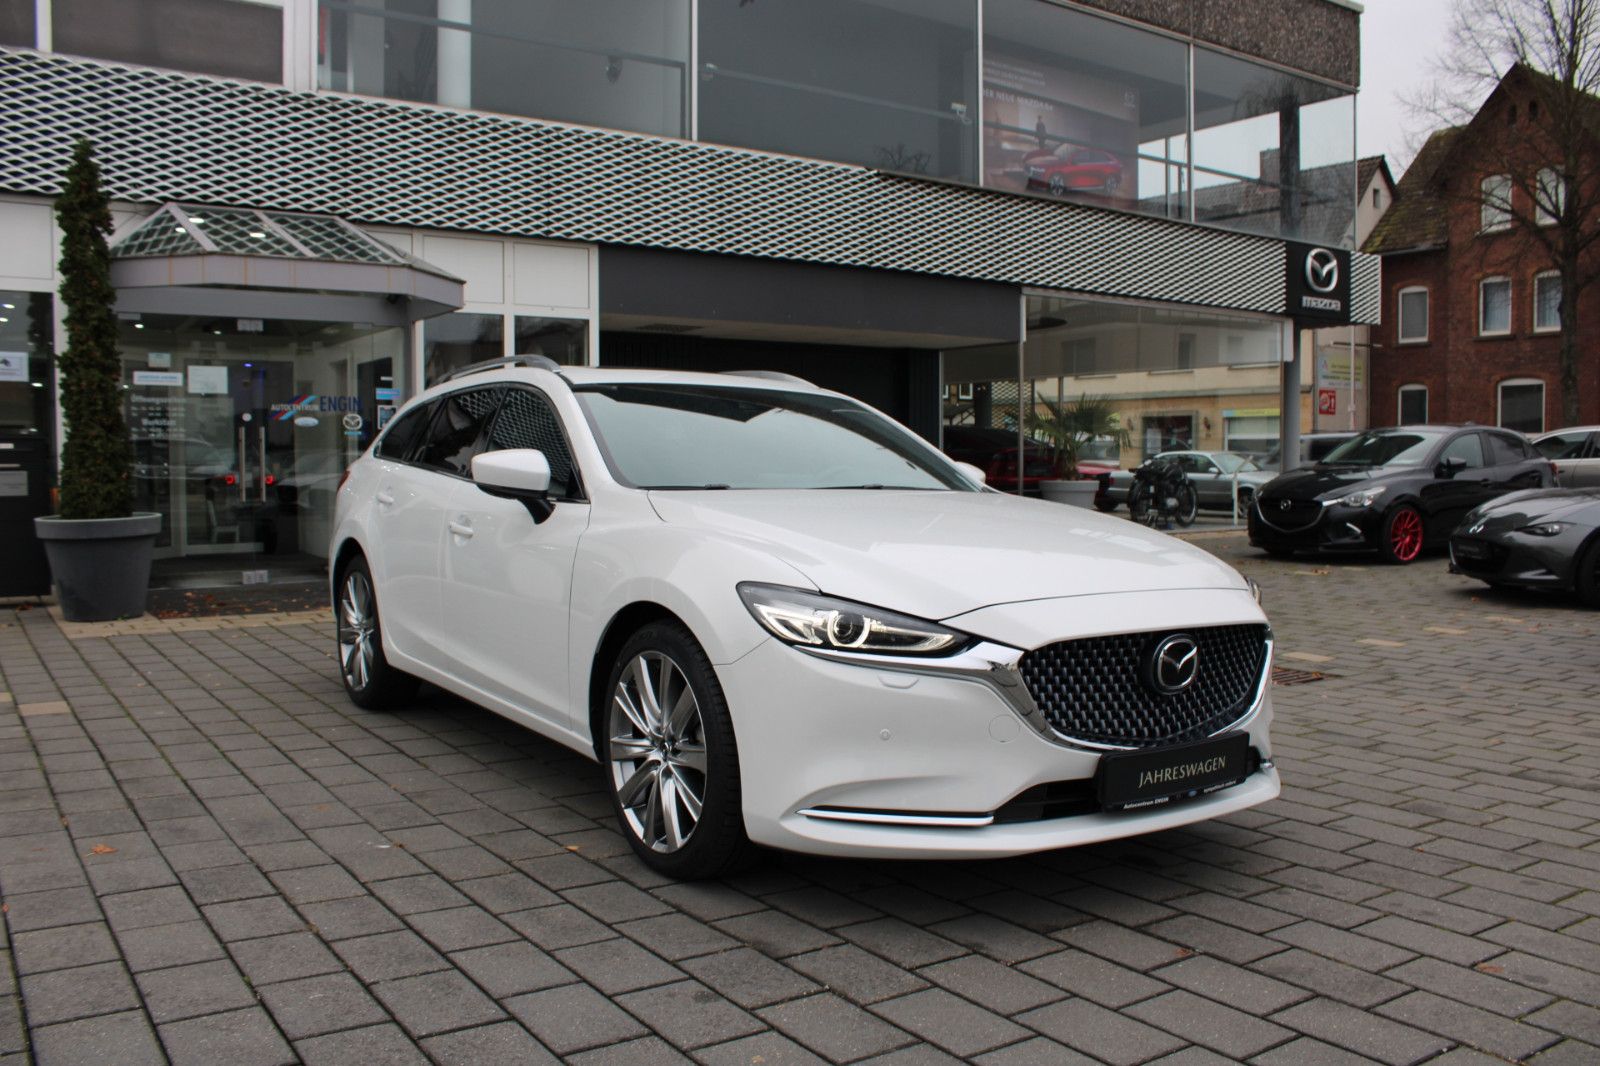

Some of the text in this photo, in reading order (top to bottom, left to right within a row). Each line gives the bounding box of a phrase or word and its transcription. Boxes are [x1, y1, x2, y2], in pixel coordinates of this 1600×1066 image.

[1302, 296, 1341, 311] mazda
[320, 395, 361, 412] ENGIN
[1138, 755, 1226, 788] JAHRESWAGEN
